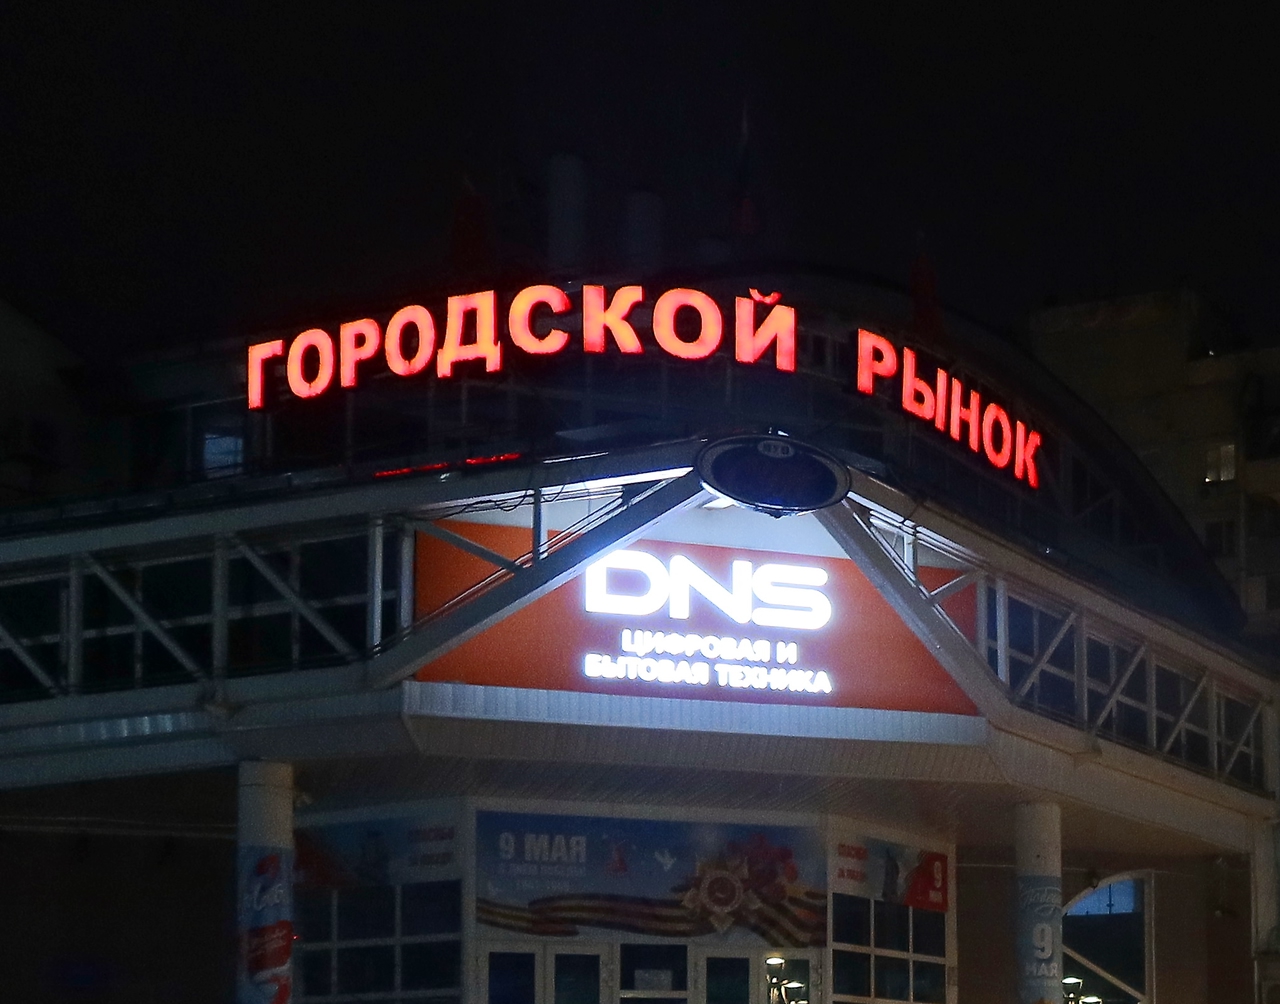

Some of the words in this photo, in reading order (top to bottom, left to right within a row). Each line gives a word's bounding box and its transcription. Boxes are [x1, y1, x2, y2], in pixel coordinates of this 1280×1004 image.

[247, 284, 797, 410] ГОРОДСКОЙ
[857, 328, 1041, 489] РЫНОК
[585, 549, 832, 630] DNS
[621, 628, 771, 662] ЦИФРОВАЯ
[776, 641, 797, 664] И
[585, 653, 709, 685] БЫТОВАЯ
[714, 663, 833, 694] ТЕХНИКА
[500, 831, 516, 861] 9
[524, 833, 587, 864] МАЯ
[1032, 922, 1053, 960] 9
